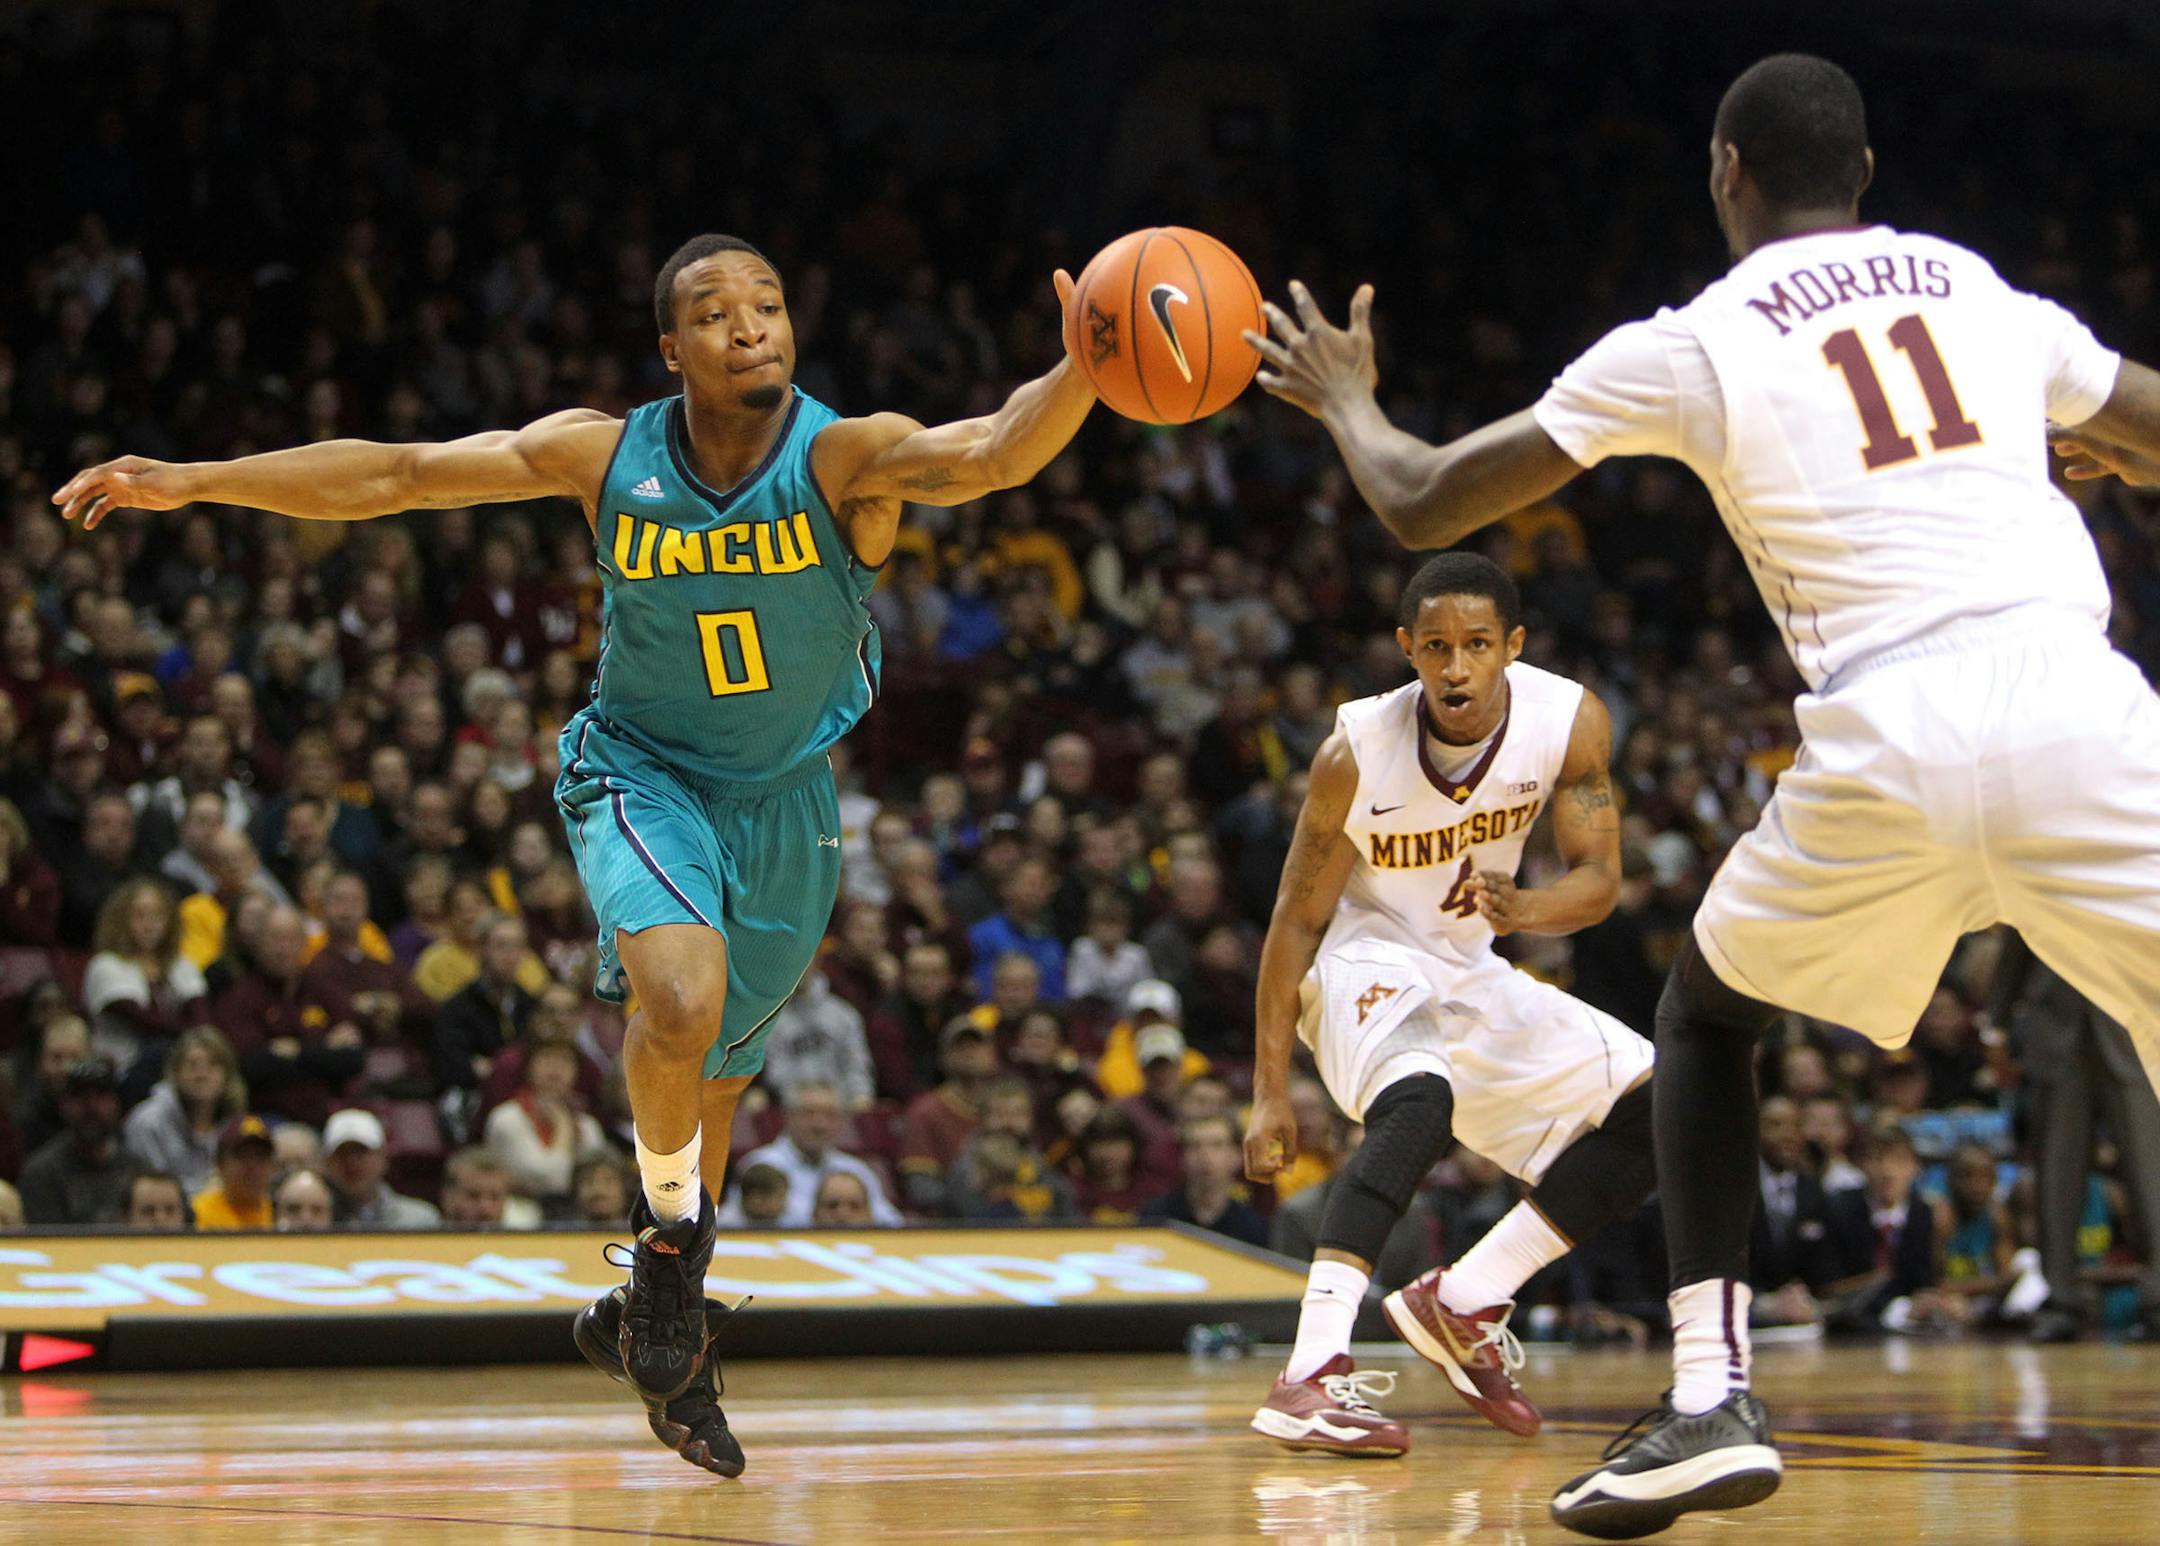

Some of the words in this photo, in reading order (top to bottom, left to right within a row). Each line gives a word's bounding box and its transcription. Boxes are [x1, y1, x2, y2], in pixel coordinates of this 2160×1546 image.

[1746, 254, 1951, 336] MORRIS
[1820, 313, 1984, 471] 11
[612, 510, 823, 580] UNCW
[693, 607, 773, 698] 0
[1438, 853, 1480, 920] 4
[614, 1239, 1210, 1307] Clips
